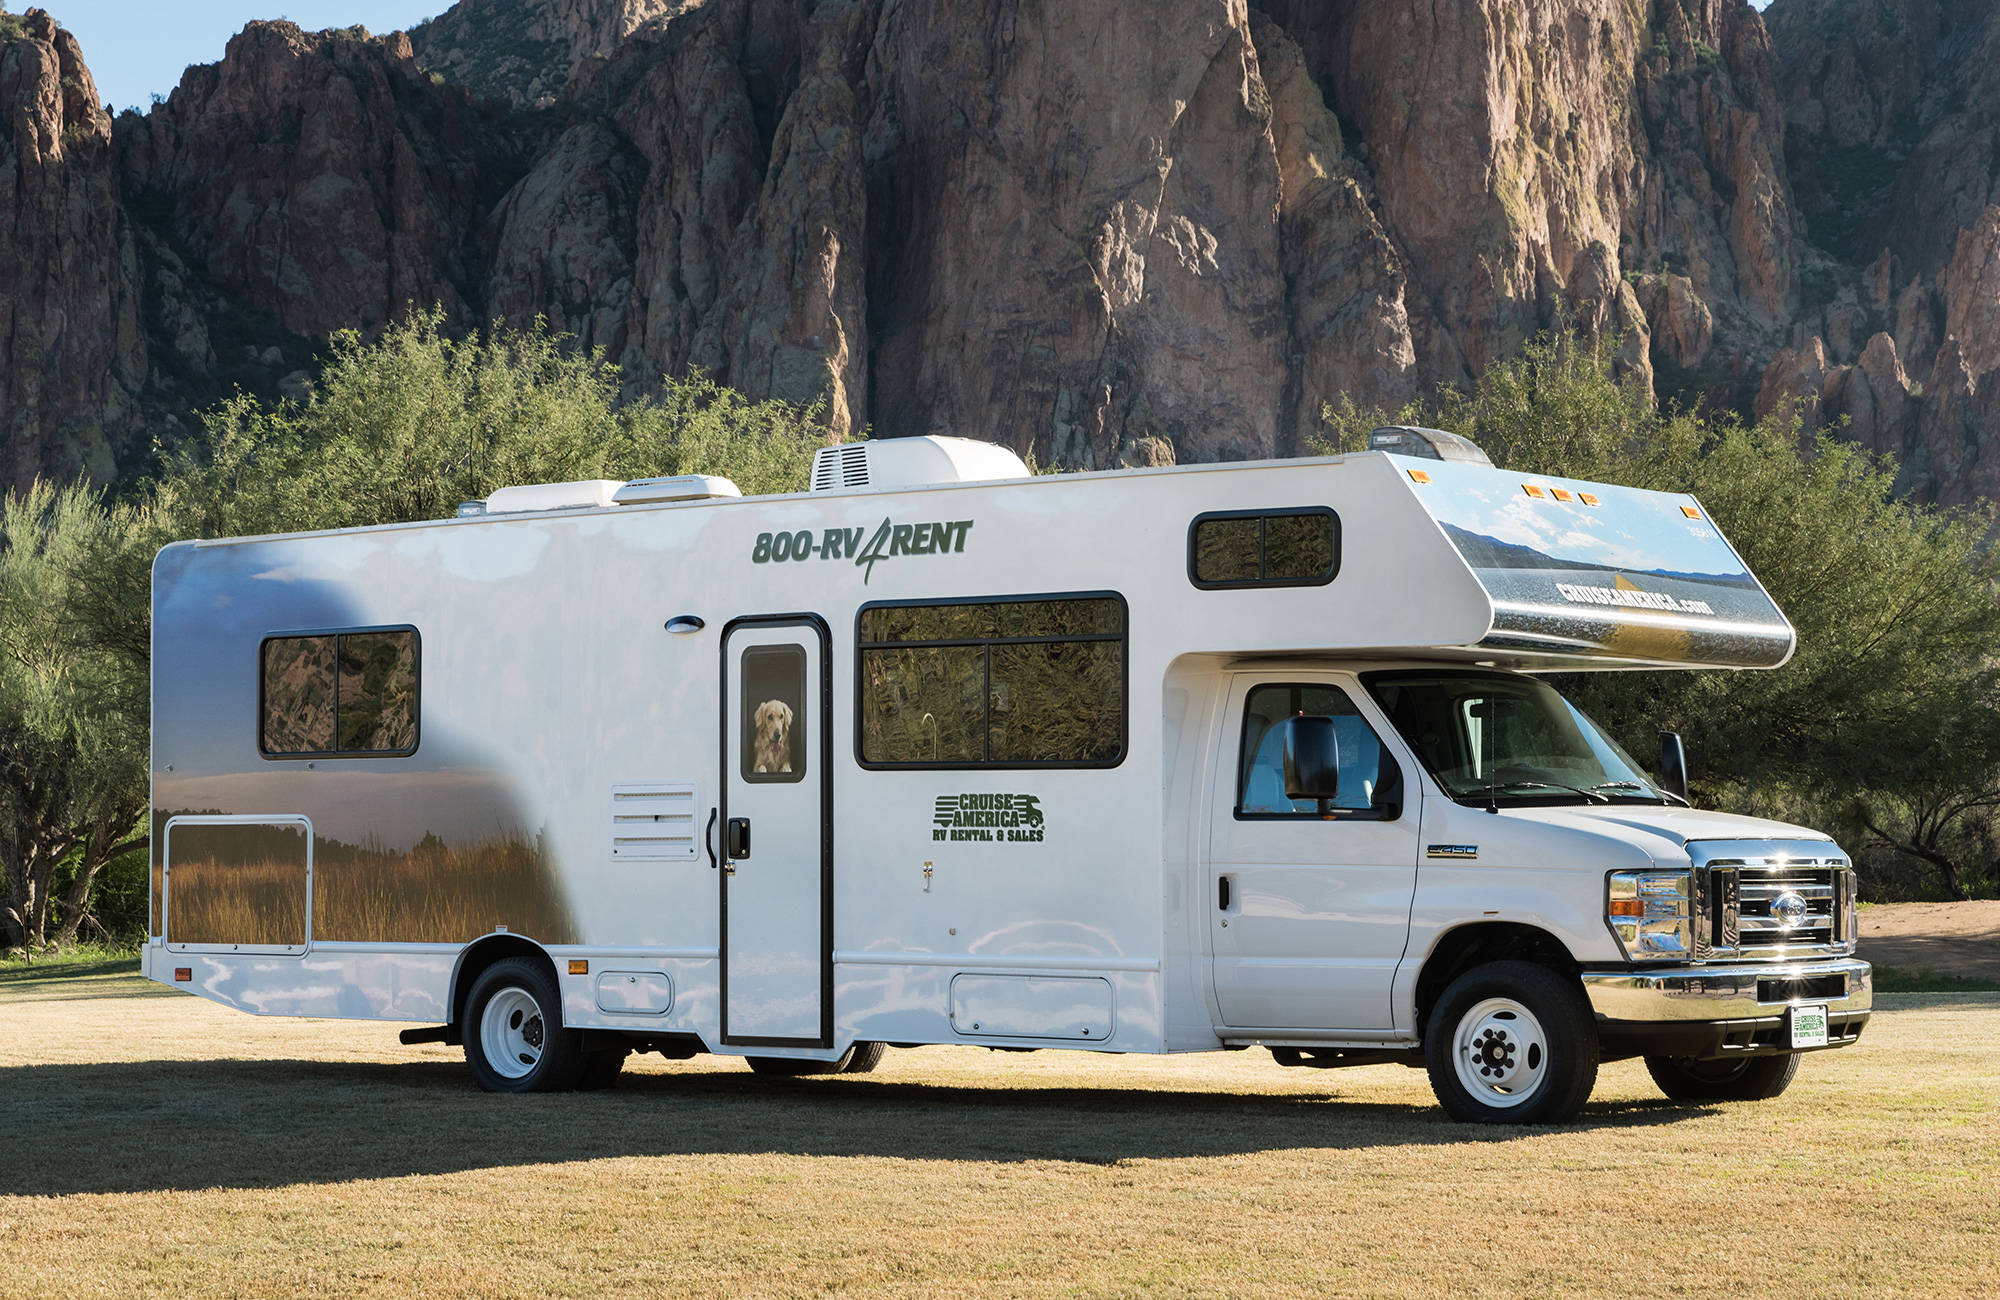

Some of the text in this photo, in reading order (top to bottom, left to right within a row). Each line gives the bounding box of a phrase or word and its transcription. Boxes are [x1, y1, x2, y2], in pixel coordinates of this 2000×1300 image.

[752, 516, 974, 586] 800-RV4RENT
[1556, 583, 1715, 615] CRUISEAMERICA.com
[959, 793, 1014, 810] CRUISE
[952, 811, 1020, 828] AMERICA
[932, 829, 1044, 842] RV RENTAL & SALES
